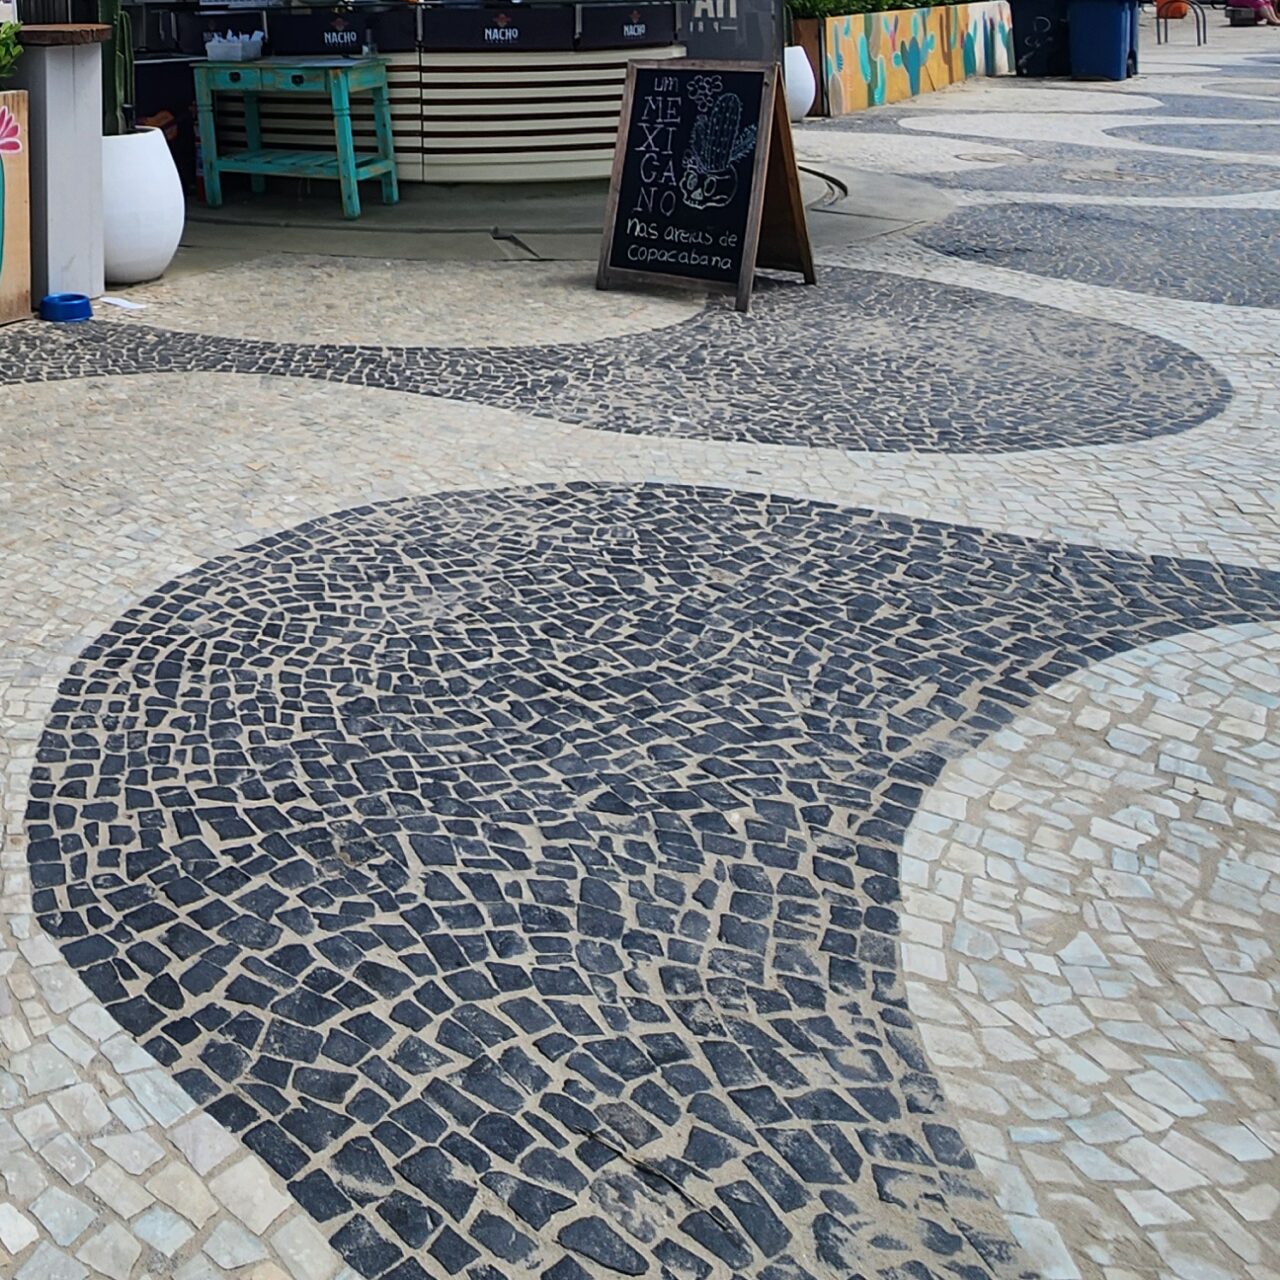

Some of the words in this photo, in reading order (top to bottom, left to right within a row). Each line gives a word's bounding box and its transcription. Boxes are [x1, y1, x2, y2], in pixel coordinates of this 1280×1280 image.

[323, 31, 357, 44] NACHO
[484, 27, 519, 40] NACHO
[641, 96, 682, 123] ME
[634, 122, 677, 155] XI
[632, 186, 677, 217] NO
[719, 230, 738, 247] de
